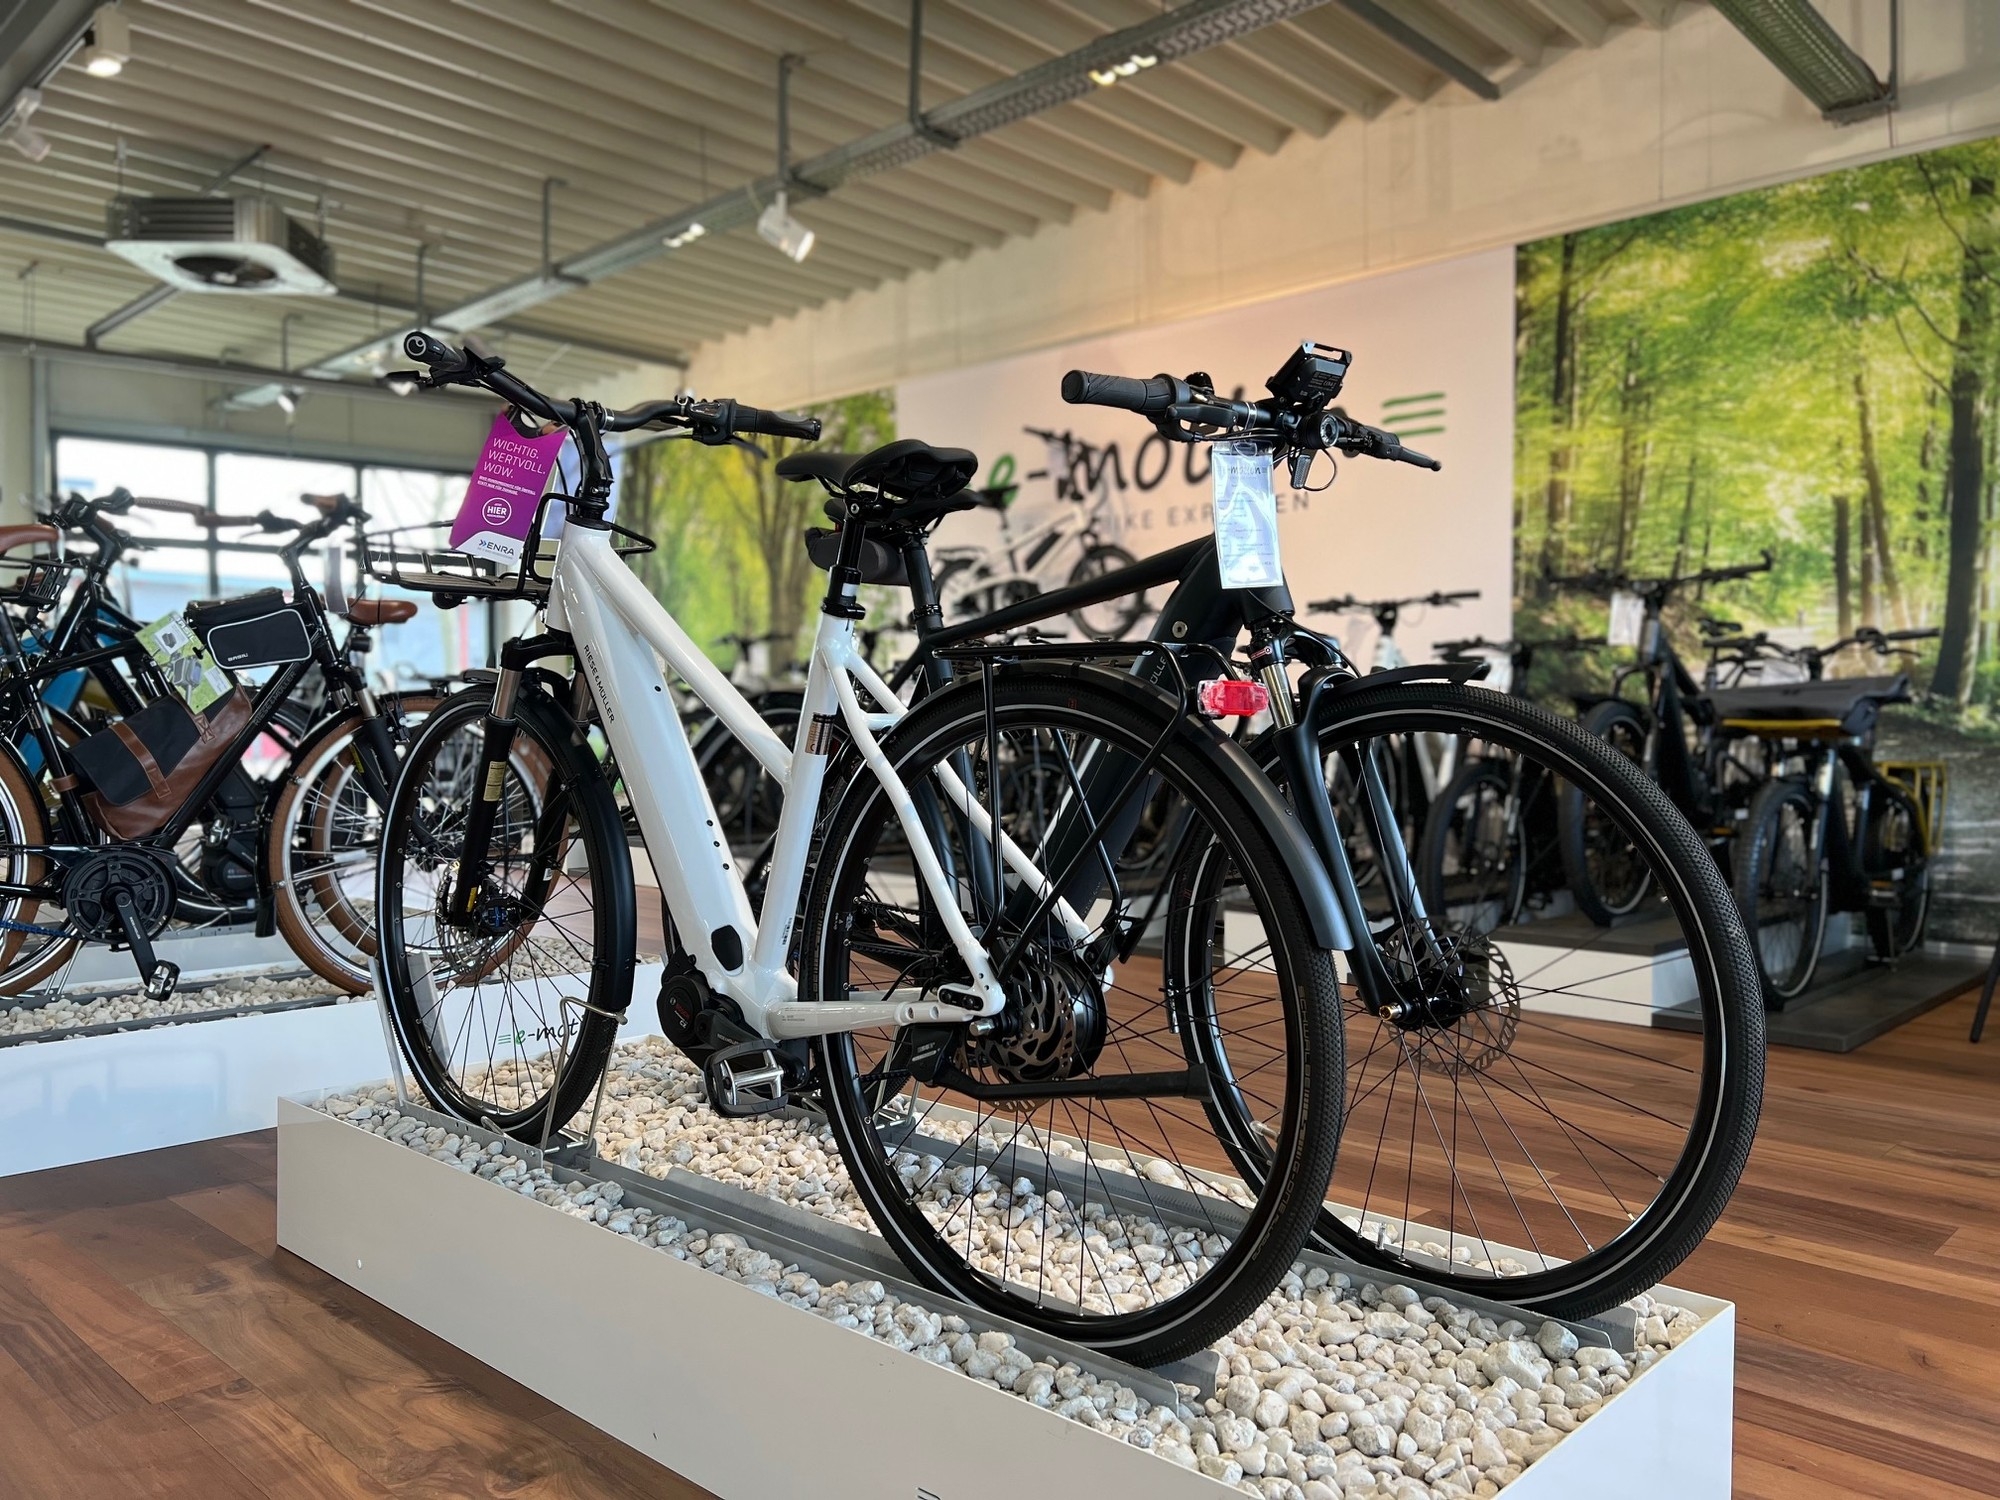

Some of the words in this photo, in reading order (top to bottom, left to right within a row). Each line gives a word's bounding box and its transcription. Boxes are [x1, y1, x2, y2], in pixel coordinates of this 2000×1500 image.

[493, 437, 540, 460] WICHTIG.
[483, 461, 514, 479] WOW.
[487, 449, 546, 475] WERTVOLL.
[487, 505, 508, 516] HIER
[486, 541, 515, 556] ENRA
[515, 1018, 580, 1045] e-mot
